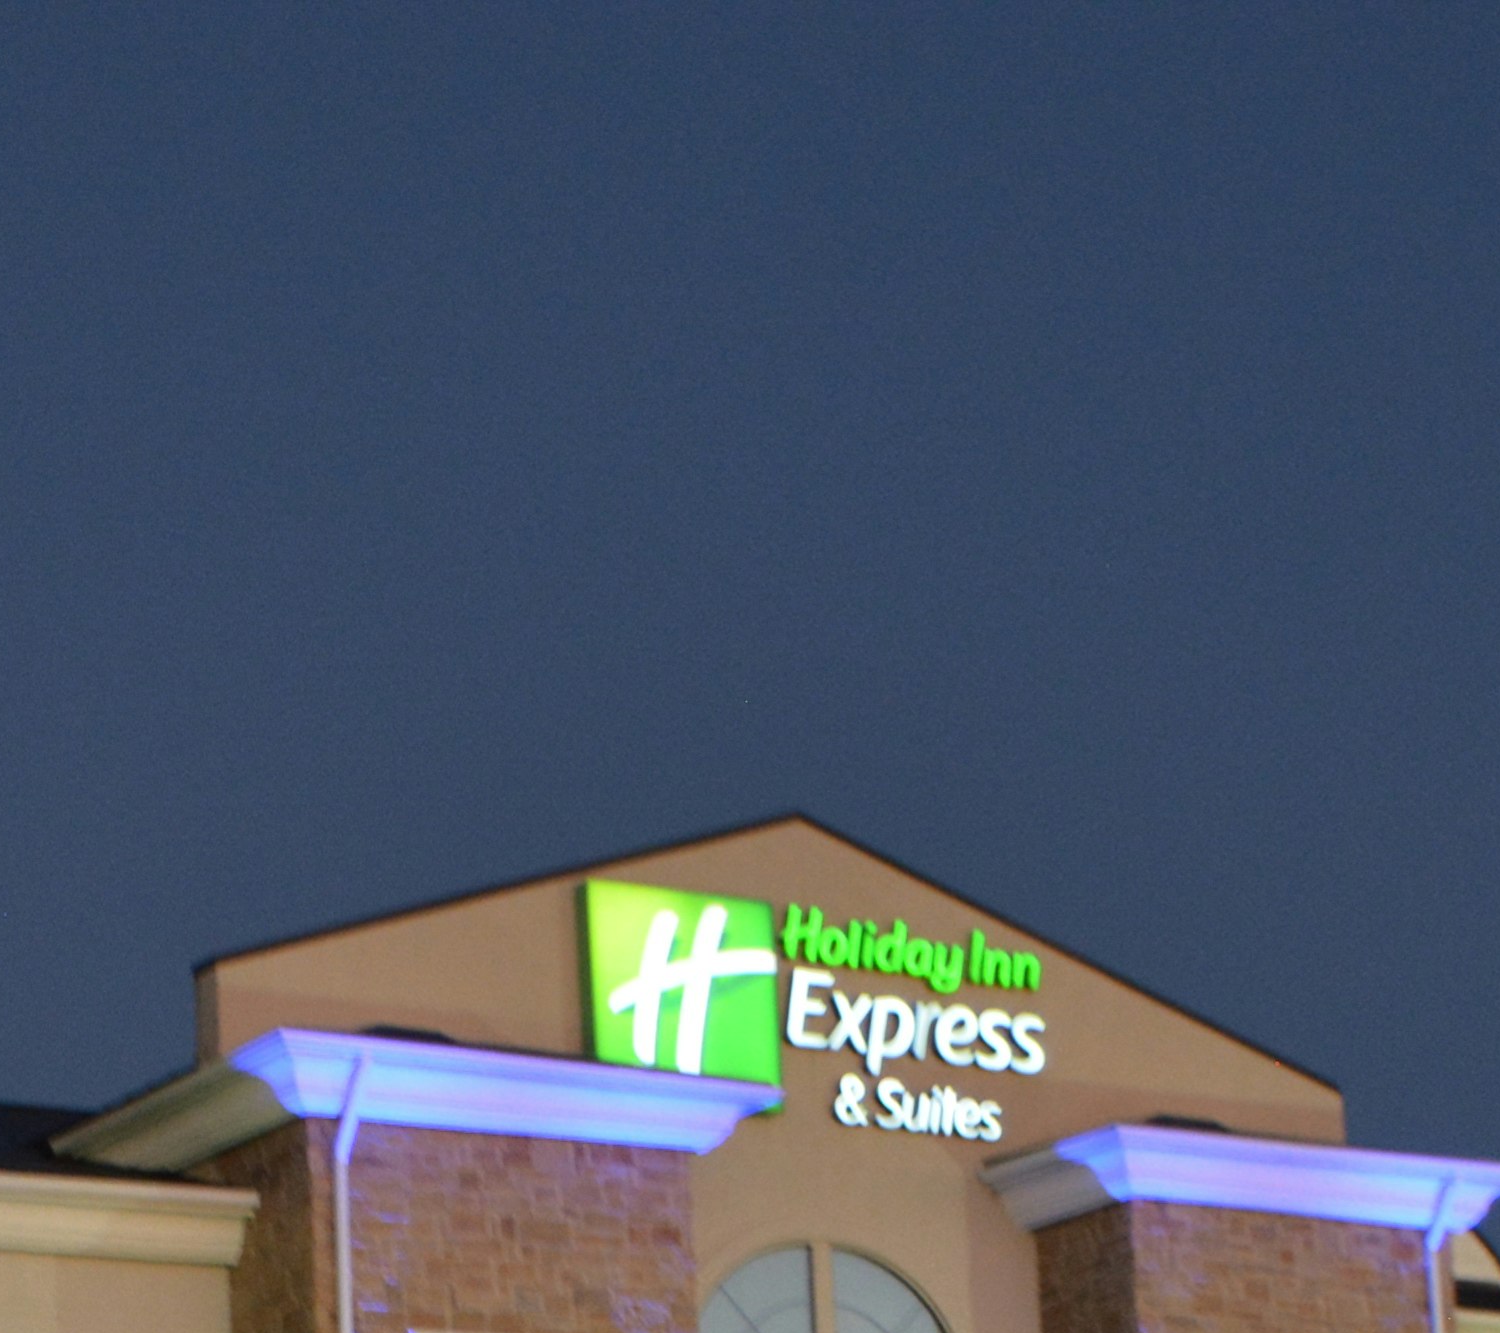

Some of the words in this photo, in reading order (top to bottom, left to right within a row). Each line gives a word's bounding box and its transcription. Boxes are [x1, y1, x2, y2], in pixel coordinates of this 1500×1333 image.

[782, 903, 963, 994] Holiday
[969, 928, 1041, 991] Inn
[785, 966, 1046, 1076] Express
[834, 1072, 868, 1127] &
[876, 1076, 1003, 1142] Suites
